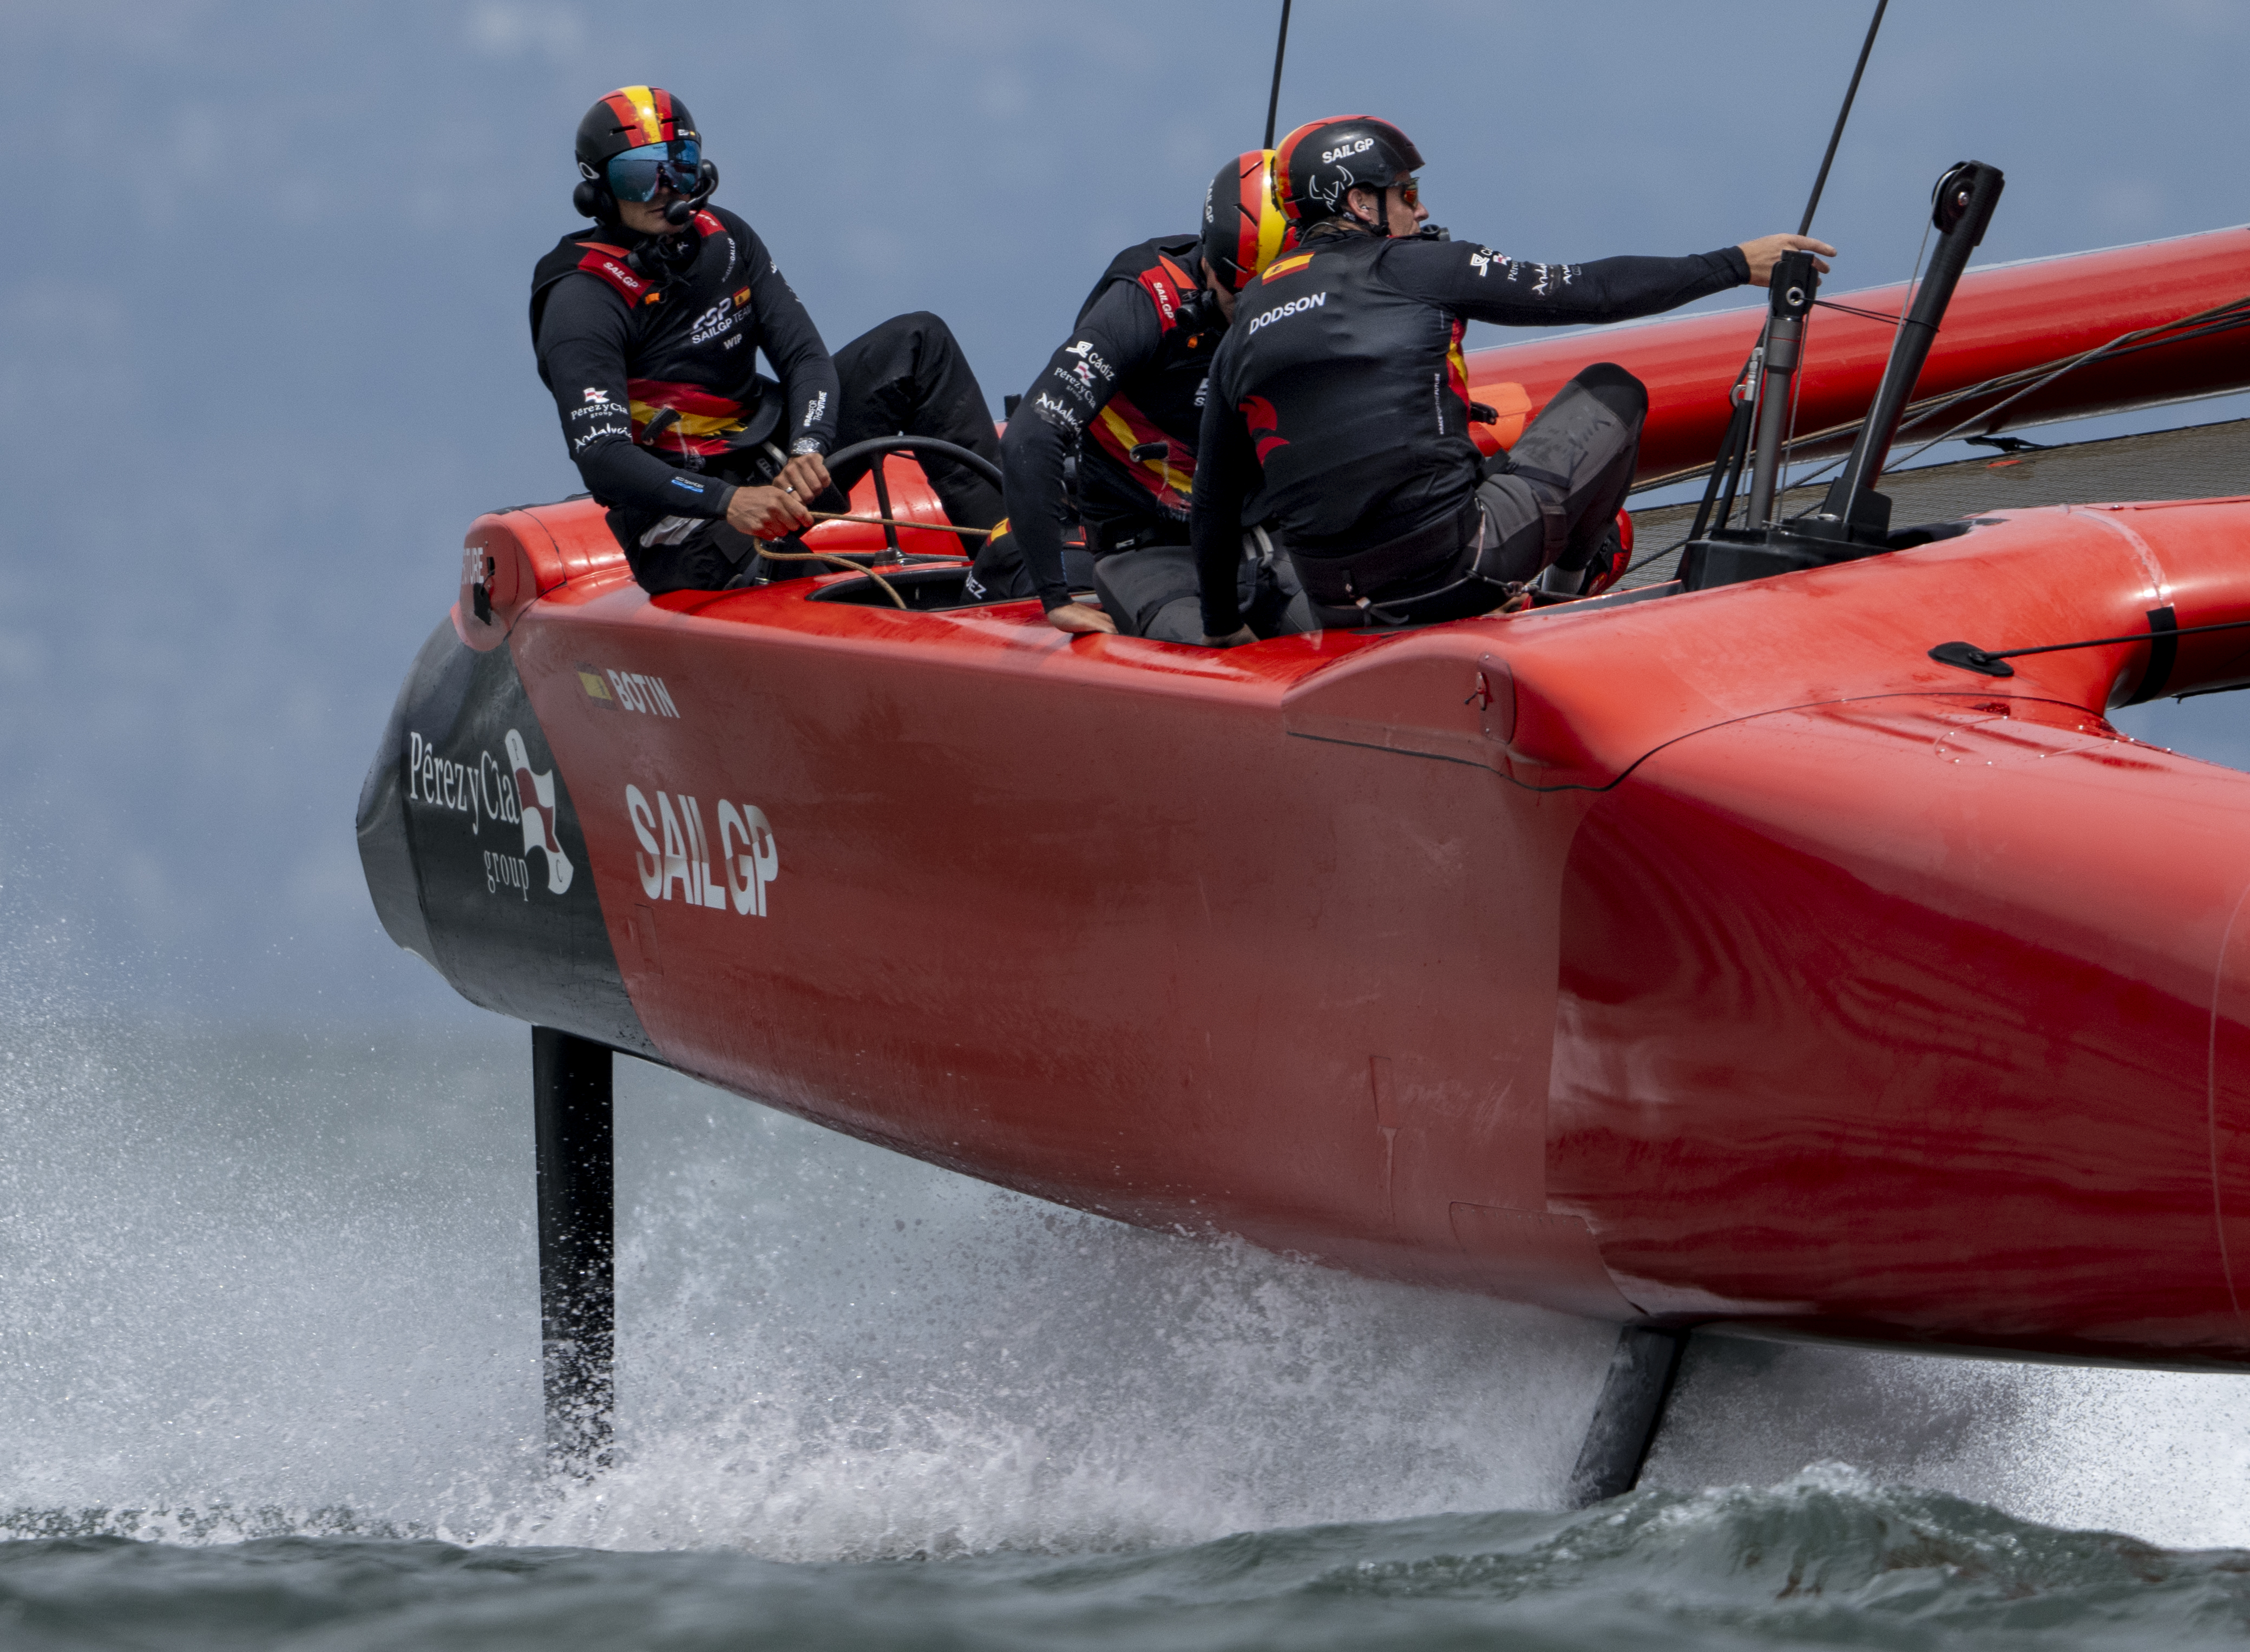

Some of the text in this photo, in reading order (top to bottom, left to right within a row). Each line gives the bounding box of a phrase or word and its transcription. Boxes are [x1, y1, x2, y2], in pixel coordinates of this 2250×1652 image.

[1322, 138, 1374, 163] SAILGP
[602, 262, 639, 288] SAILGP
[1153, 282, 1175, 319] SAILGP
[1249, 292, 1327, 335] DODSON
[692, 318, 733, 344] SAILGP
[723, 333, 742, 350] WIP
[1088, 352, 1115, 381] Cádiz
[606, 668, 681, 719] BOTIN
[626, 784, 779, 917] SAILGP
[484, 850, 529, 902] group
